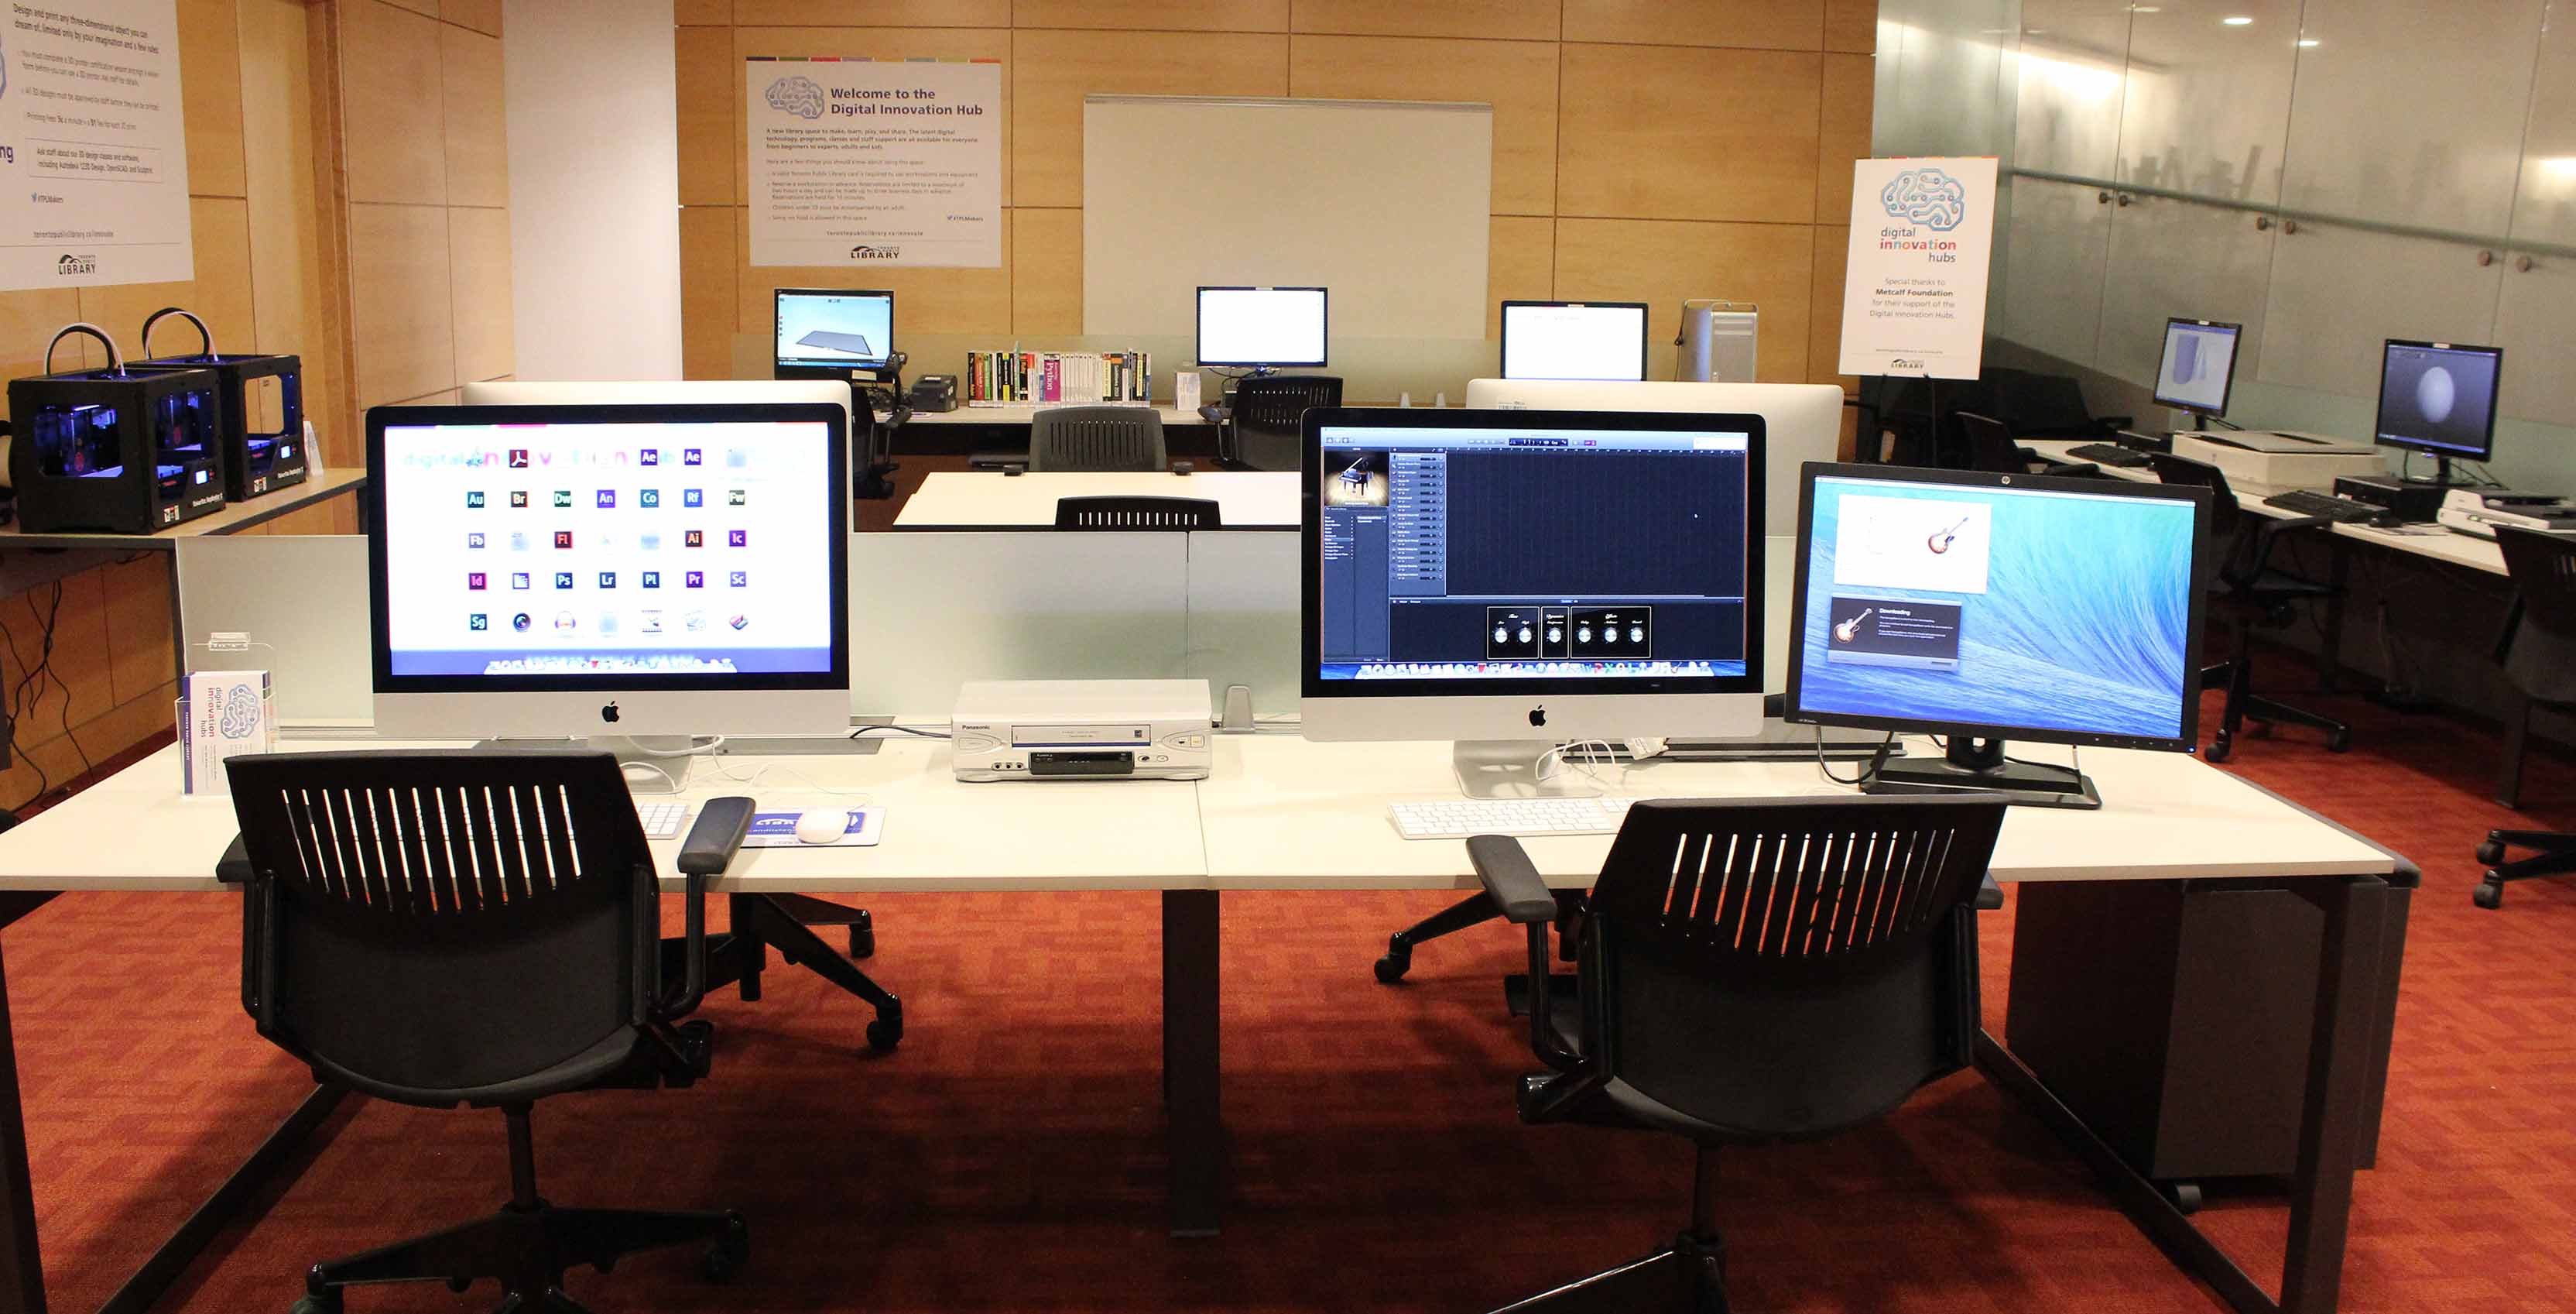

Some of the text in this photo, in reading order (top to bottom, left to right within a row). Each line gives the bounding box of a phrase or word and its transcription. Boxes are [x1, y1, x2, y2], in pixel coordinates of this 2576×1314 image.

[831, 88, 935, 99] Welcome to the
[831, 105, 983, 117] Digital Innovation Hub
[1881, 227, 1916, 239] digital
[1880, 238, 1956, 251] innovation
[1929, 252, 1956, 263] hubs
[58, 263, 96, 275] LIBRARY
[1885, 278, 1910, 286] Special
[1870, 310, 1893, 318] Digital
[1045, 362, 1054, 390] Python
[641, 452, 656, 463] Ae
[685, 452, 700, 462] Ae
[469, 494, 483, 505] Au
[512, 494, 526, 503] Br
[554, 494, 570, 504] Dw
[599, 494, 613, 503] An
[642, 493, 657, 503] Co
[687, 492, 699, 502] Rf
[729, 492, 745, 502] Fw
[470, 535, 483, 545] Fb
[687, 534, 700, 544] Ai
[471, 576, 483, 587] Id
[558, 576, 570, 585] Ps
[601, 575, 613, 585] Lr
[687, 575, 700, 585] Pr
[731, 574, 745, 585] Sc
[1879, 608, 1911, 616] Downloading
[472, 616, 486, 629] Sg
